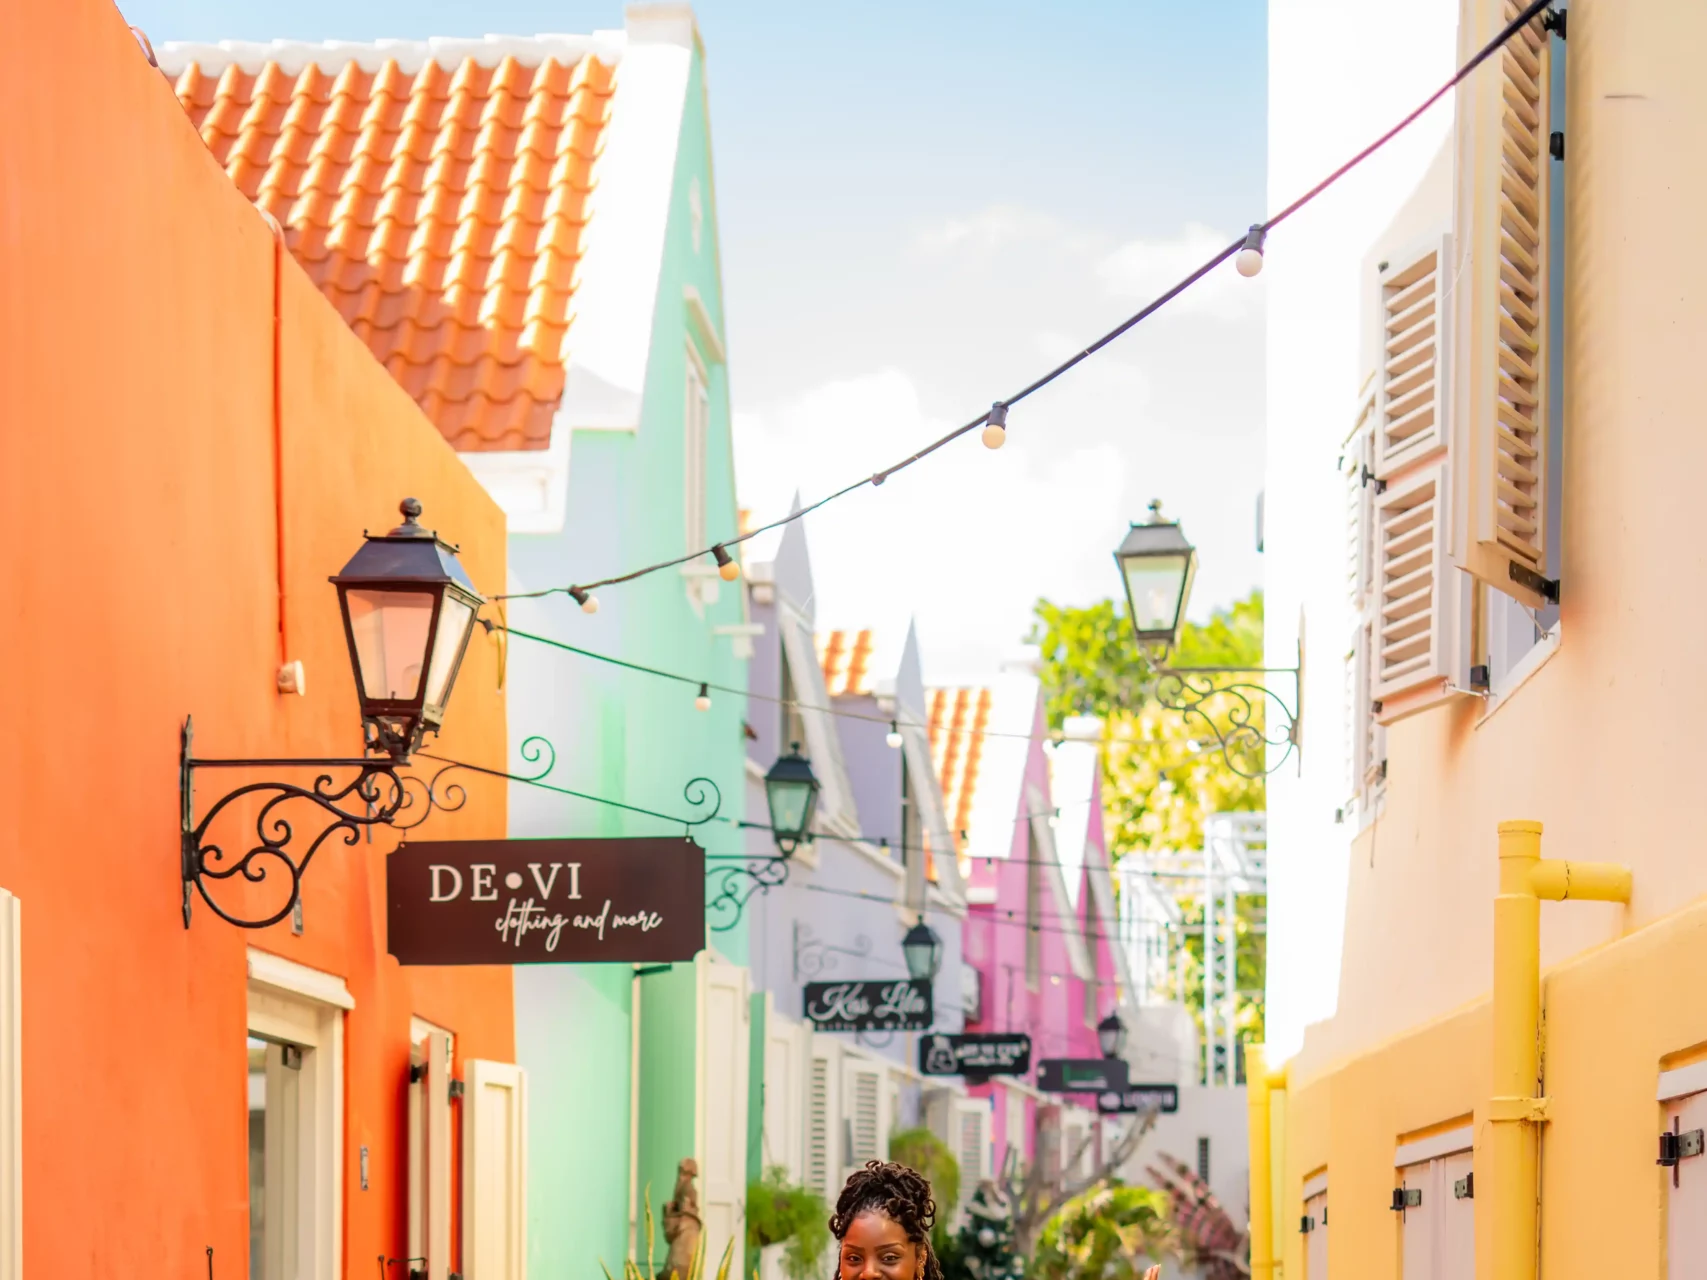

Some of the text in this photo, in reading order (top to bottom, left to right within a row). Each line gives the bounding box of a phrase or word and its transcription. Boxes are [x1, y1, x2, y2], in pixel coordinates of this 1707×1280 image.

[495, 898, 663, 952] clothing and more
